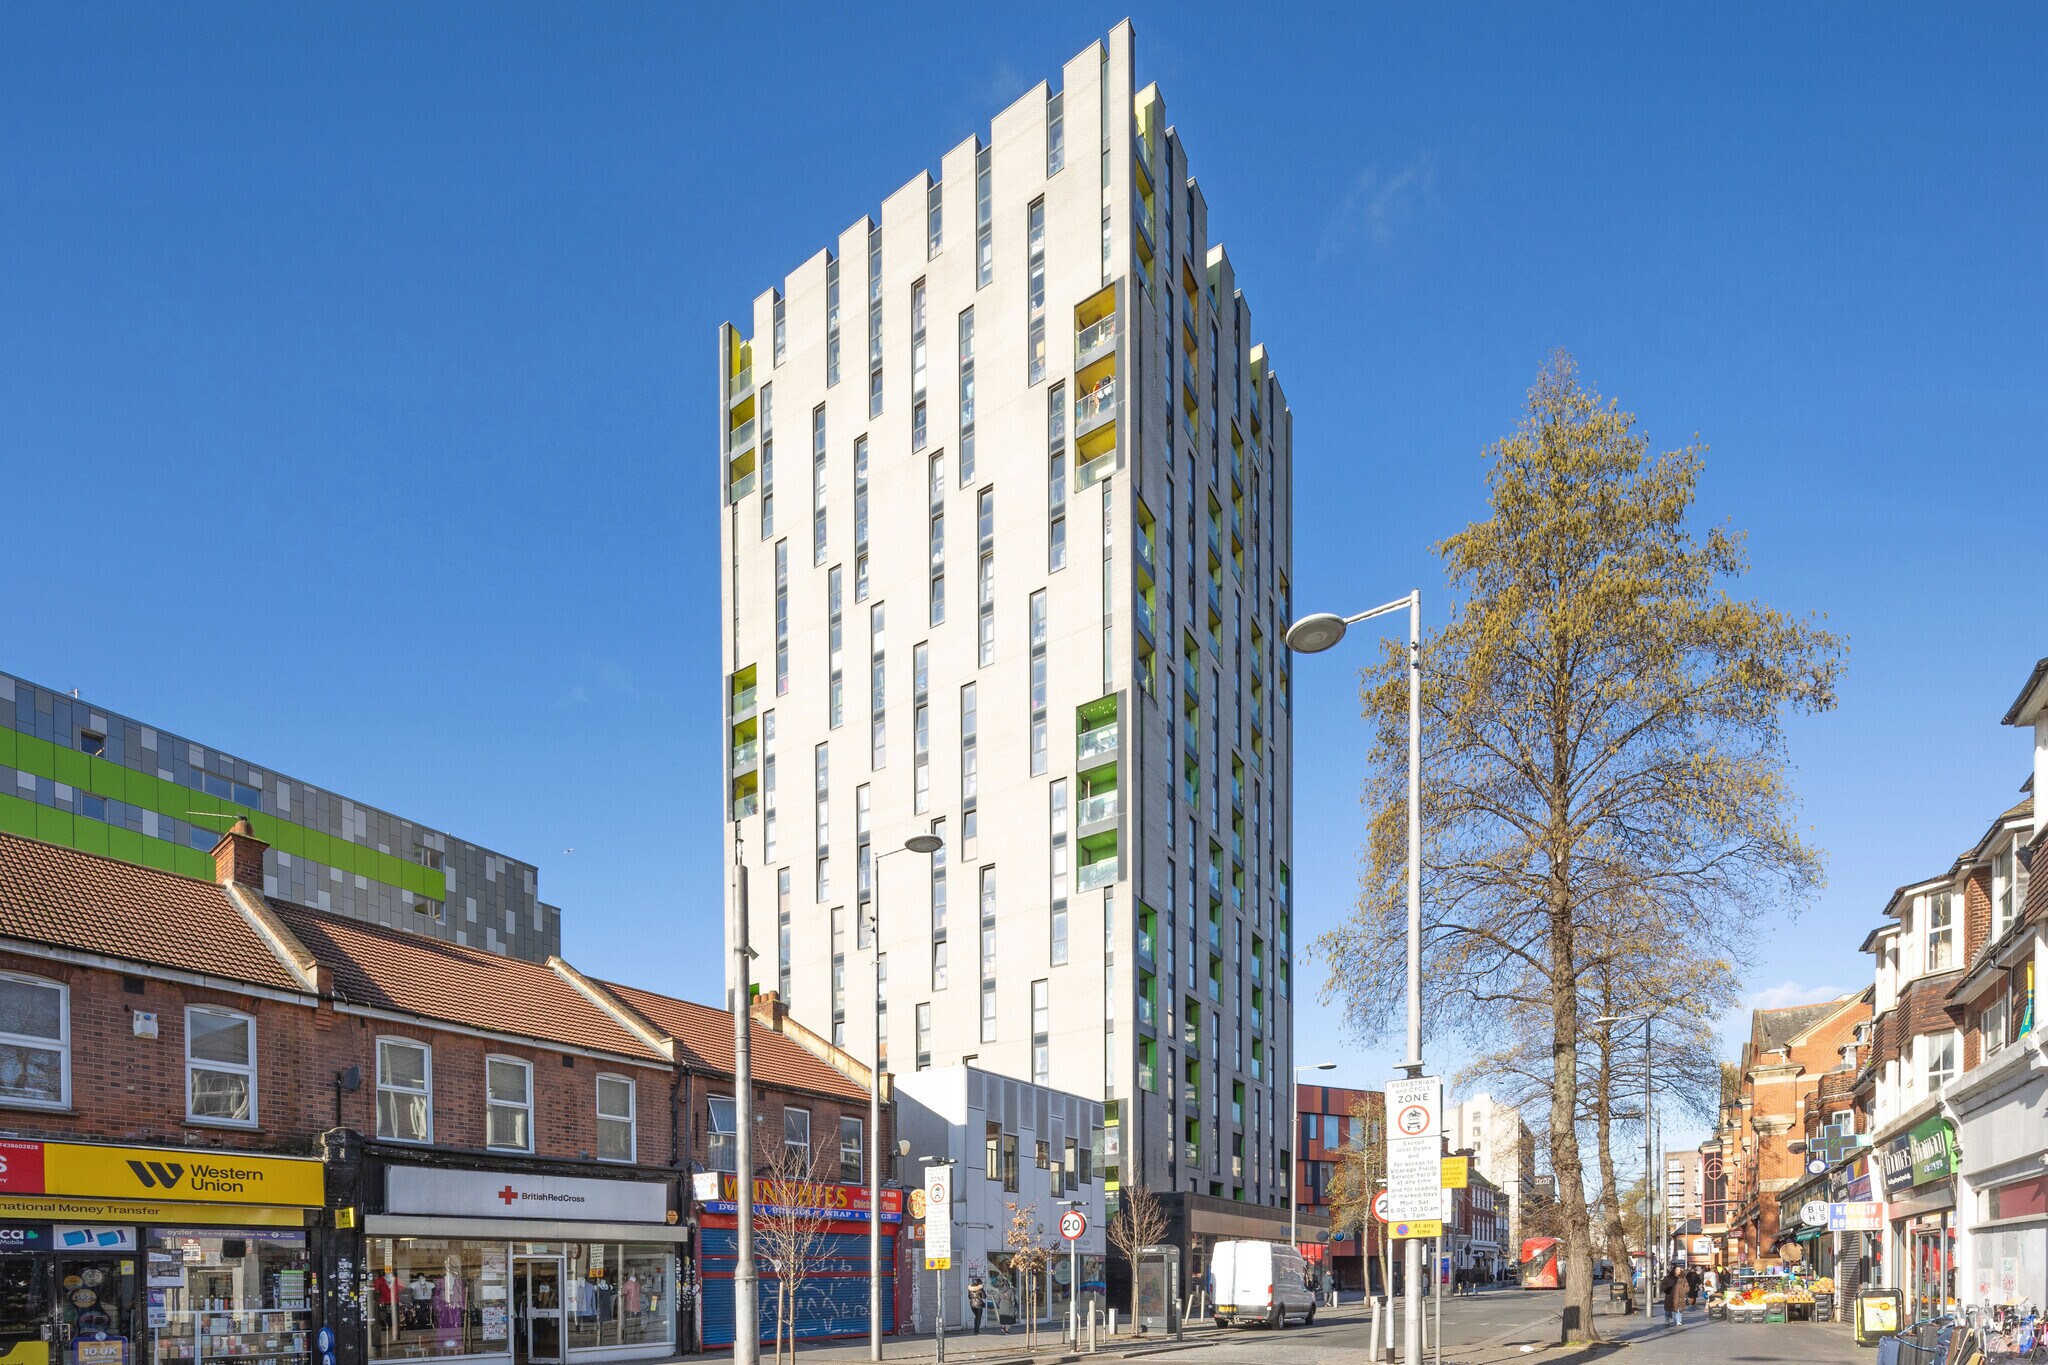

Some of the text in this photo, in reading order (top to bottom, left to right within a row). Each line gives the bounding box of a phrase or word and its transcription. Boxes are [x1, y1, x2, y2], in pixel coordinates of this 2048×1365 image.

[1392, 1079, 1435, 1088] PEDESTRIAN
[1398, 1093, 1429, 1103] ZONE
[190, 1164, 264, 1181] Western
[191, 1178, 244, 1193] Union
[0, 1202, 161, 1216] national Money Transfer
[1379, 1200, 1388, 1213] 2
[824, 1210, 852, 1219] WRAP
[865, 1212, 892, 1221] WGS
[1063, 1219, 1080, 1231] 20
[0, 1229, 24, 1239] ca
[100, 1347, 118, 1355] UK
